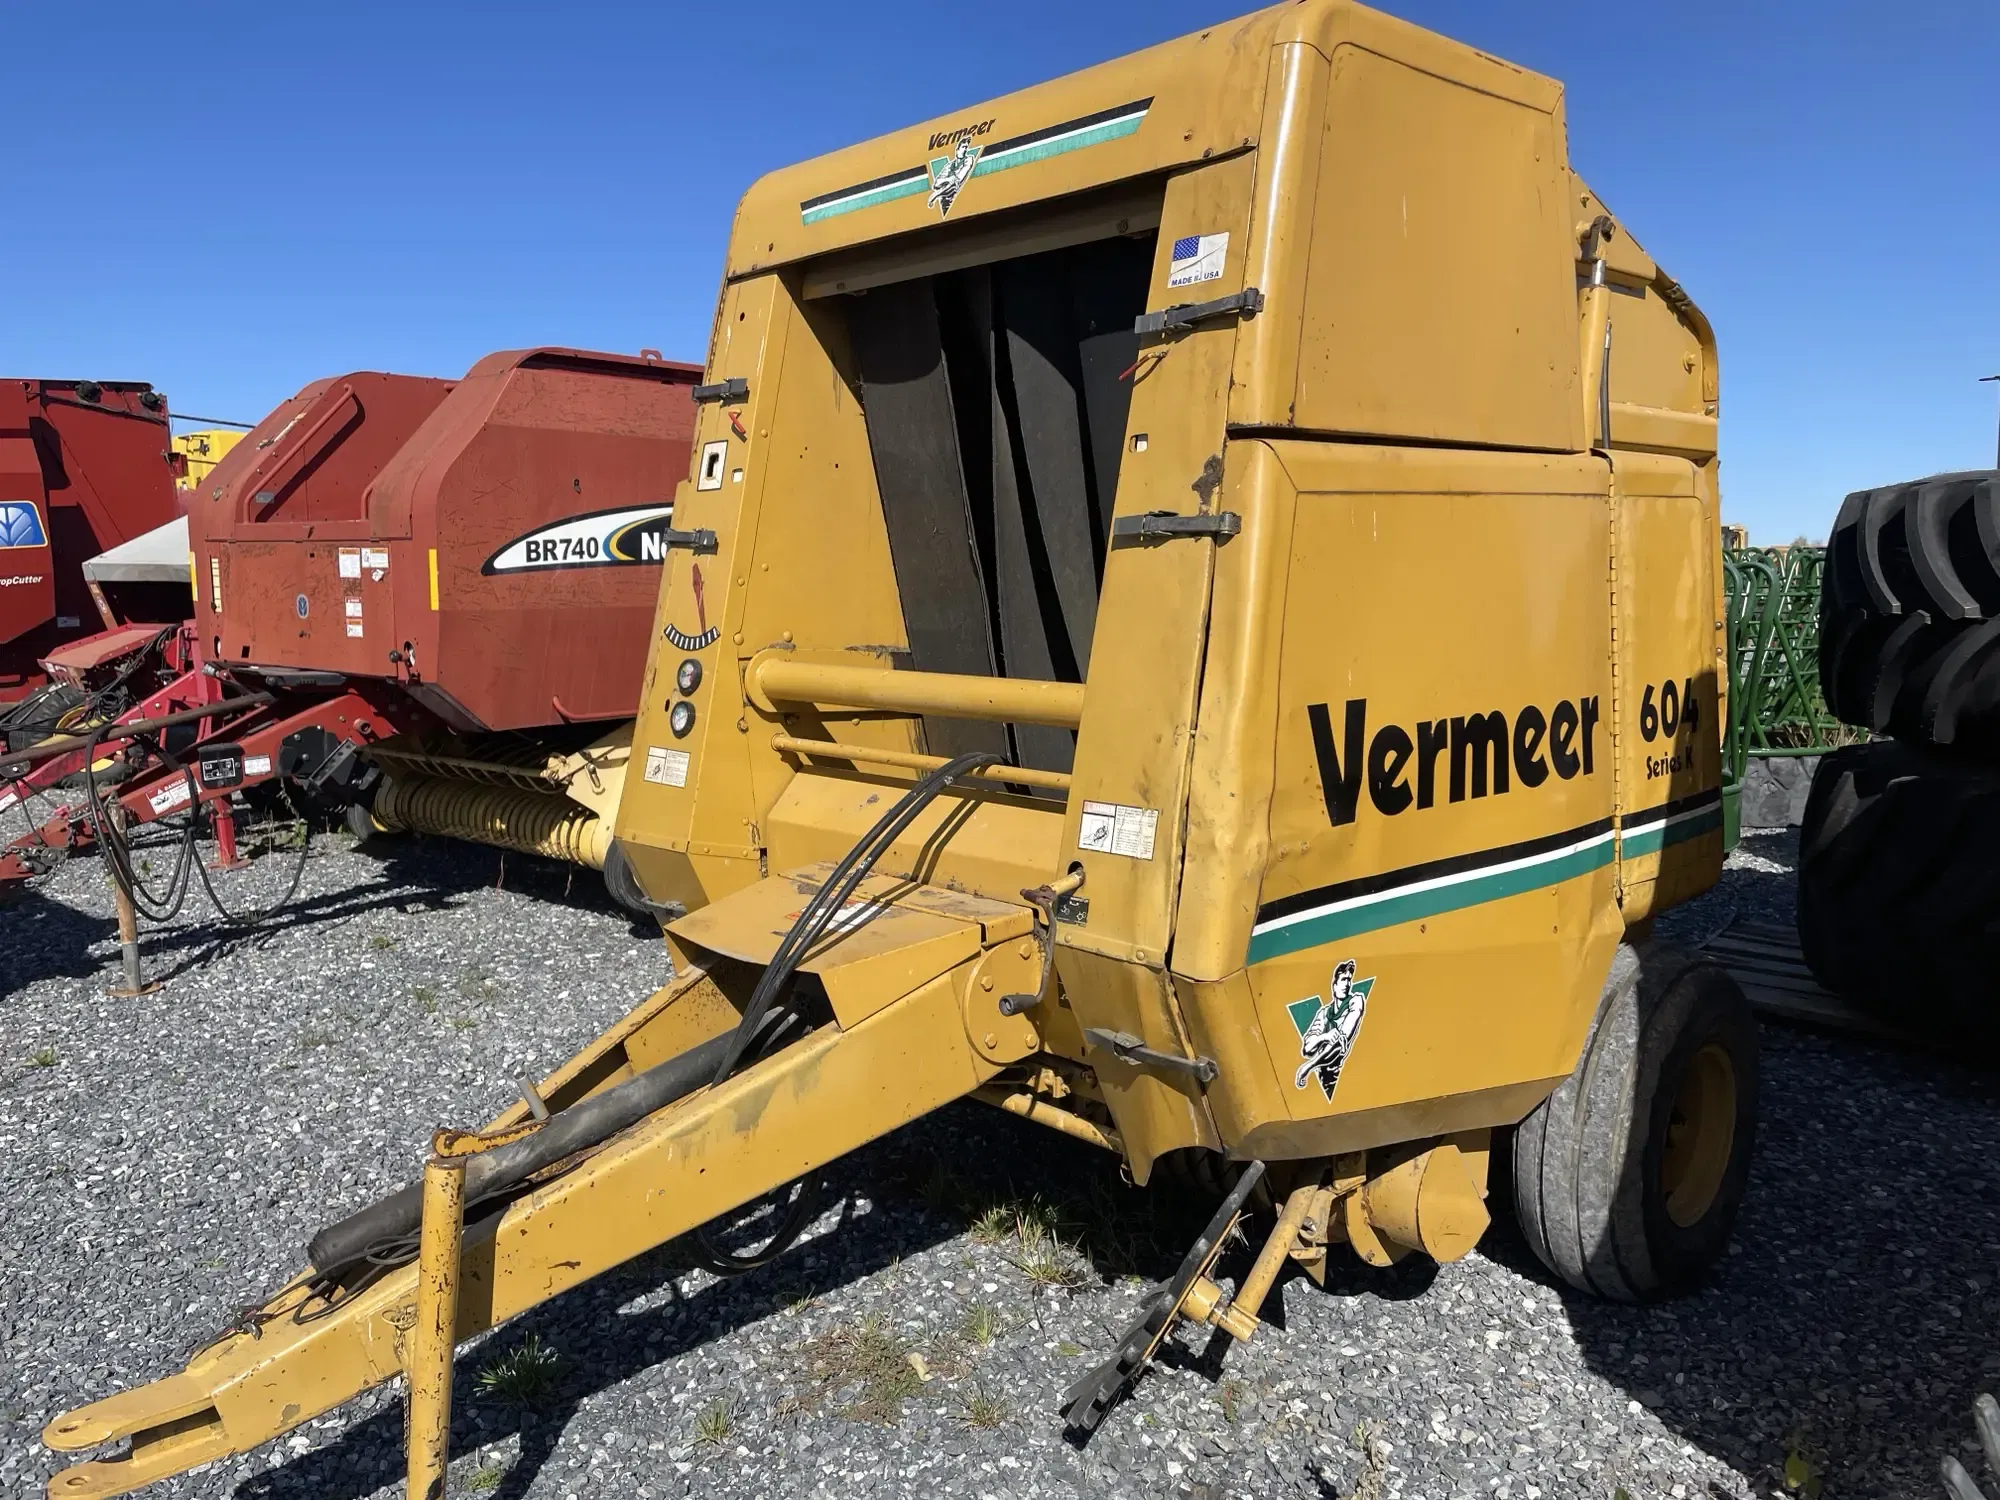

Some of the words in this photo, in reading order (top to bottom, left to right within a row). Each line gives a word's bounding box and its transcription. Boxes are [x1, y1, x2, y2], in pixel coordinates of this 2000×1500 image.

[928, 118, 996, 151] Vermeer
[1171, 276, 1193, 287] MADE
[1204, 270, 1220, 280] USA
[526, 537, 599, 563] BR740
[1640, 678, 1698, 742] 604
[1307, 695, 1599, 827] Vermeer
[1646, 752, 1681, 780] Series
[1685, 745, 1694, 770] K
